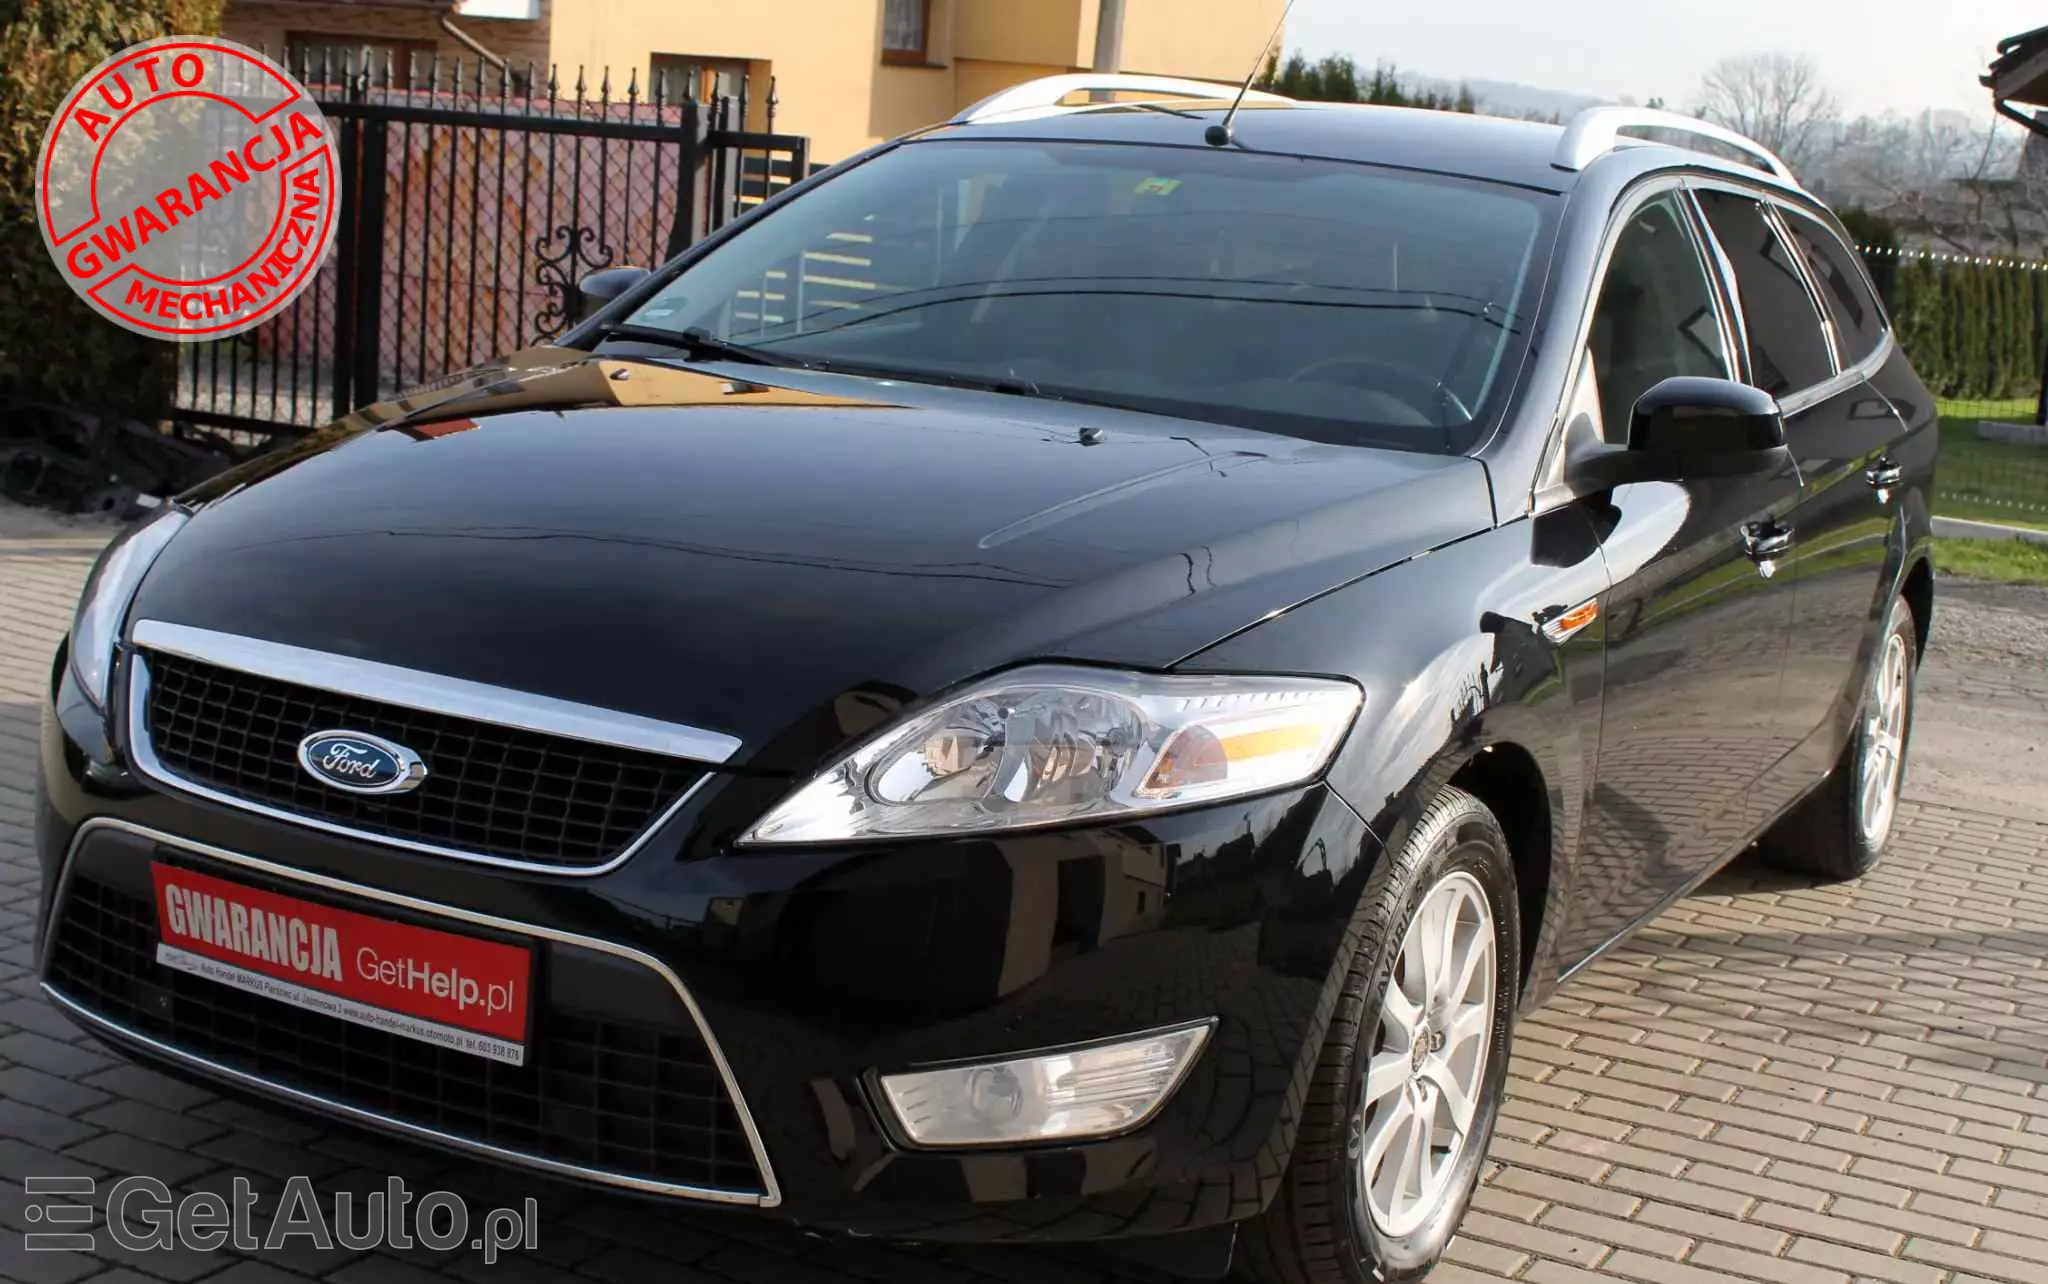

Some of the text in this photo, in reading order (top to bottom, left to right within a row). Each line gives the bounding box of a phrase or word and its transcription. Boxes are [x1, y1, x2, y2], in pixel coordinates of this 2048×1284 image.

[322, 743, 381, 778] Ford
[164, 883, 515, 1016] GWARANCJA GetHelp.pl
